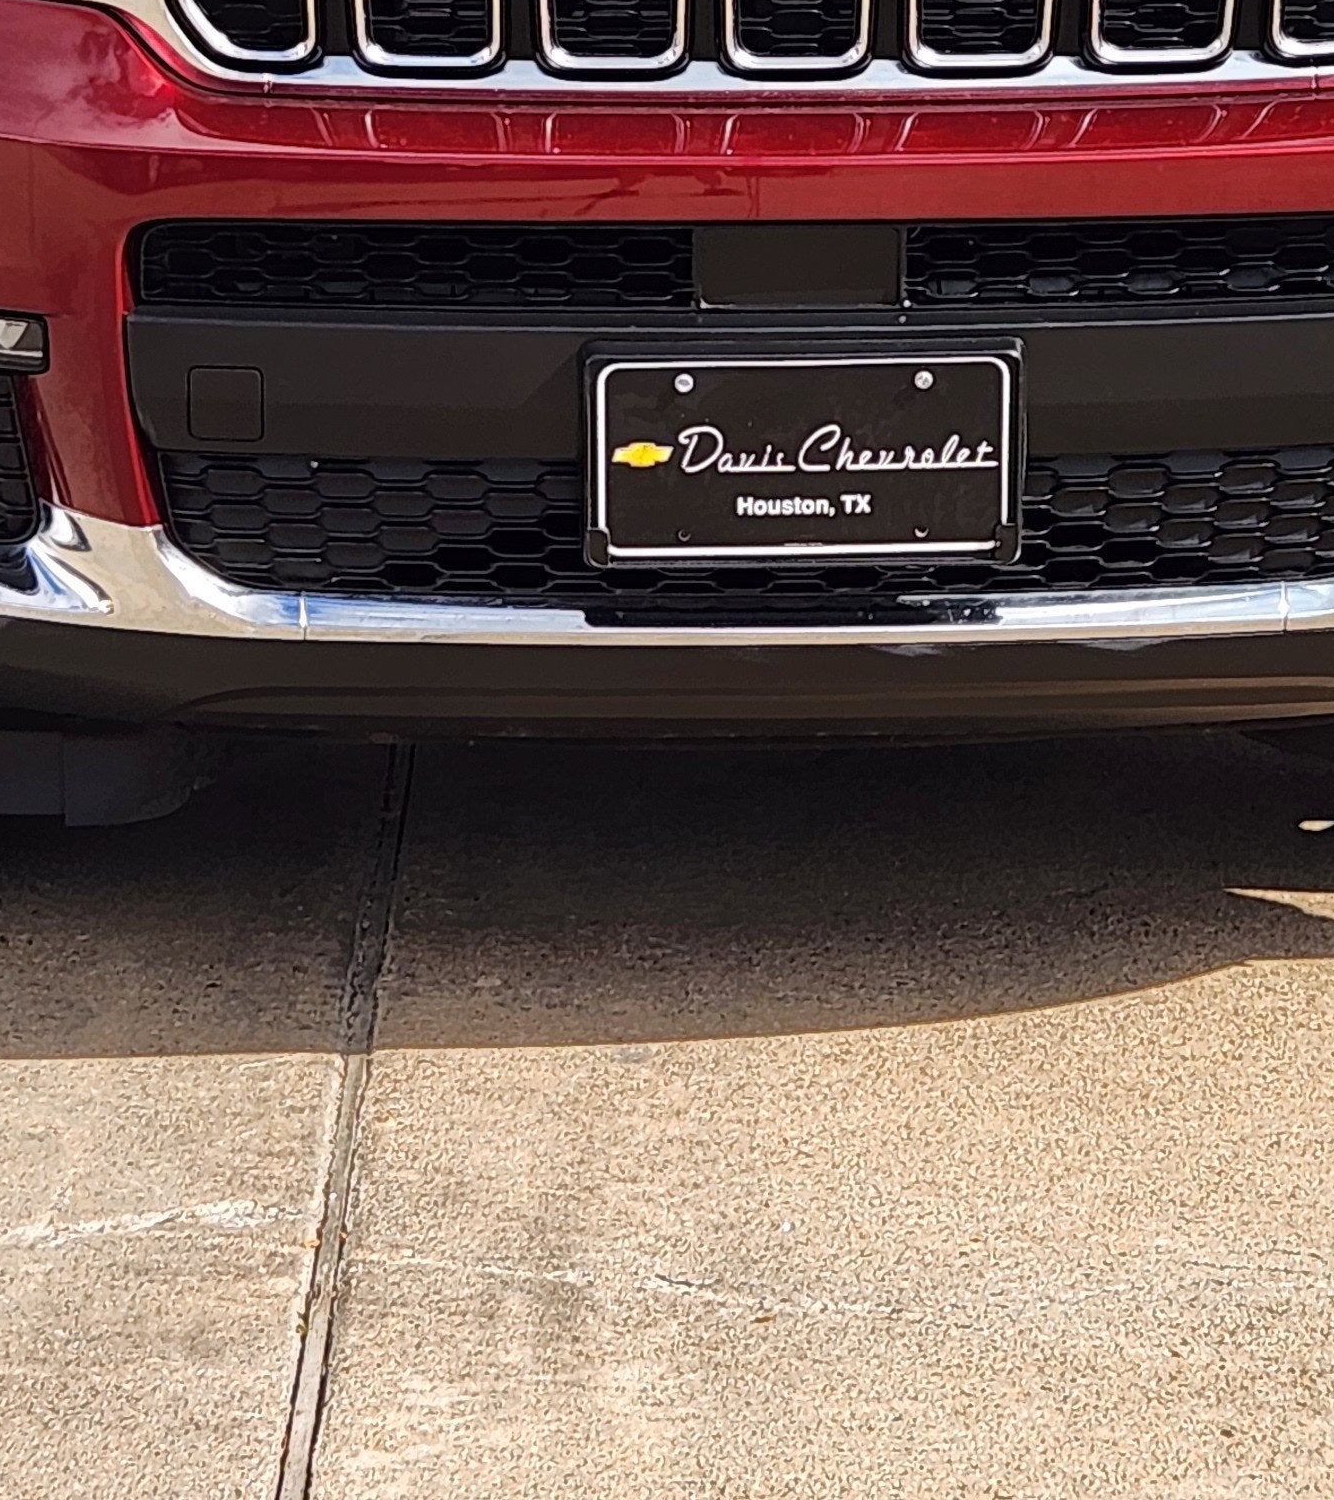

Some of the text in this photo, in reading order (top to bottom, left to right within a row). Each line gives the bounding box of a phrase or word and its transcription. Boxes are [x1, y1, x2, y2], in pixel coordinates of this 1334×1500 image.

[678, 424, 999, 473] Davis Chevrolet
[736, 493, 872, 517] Houston, TX
